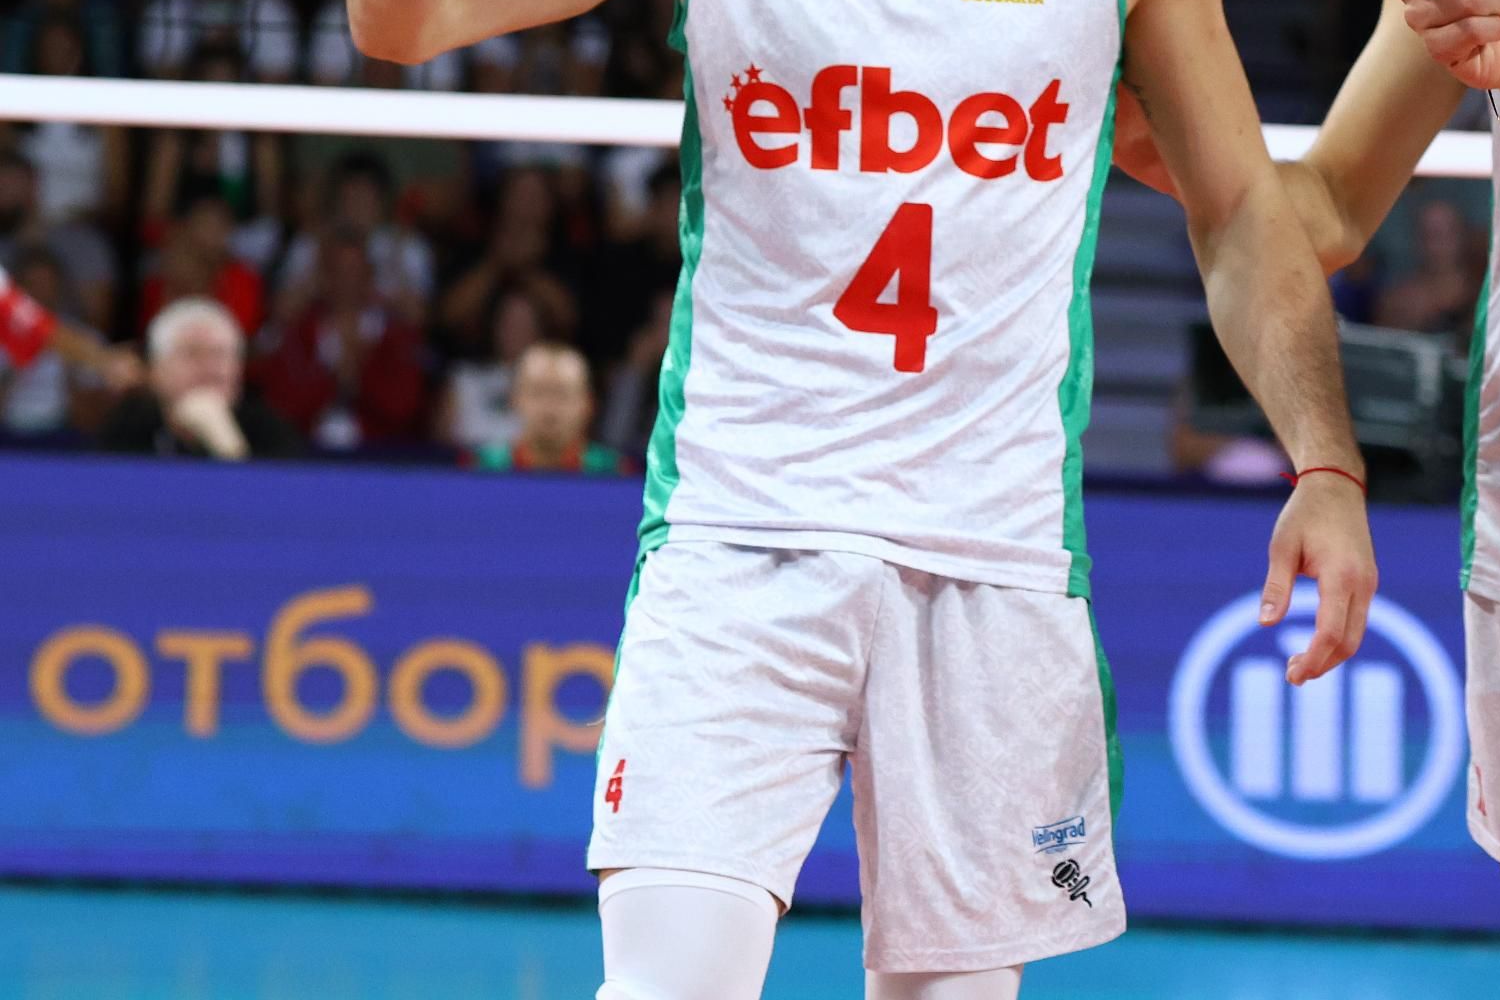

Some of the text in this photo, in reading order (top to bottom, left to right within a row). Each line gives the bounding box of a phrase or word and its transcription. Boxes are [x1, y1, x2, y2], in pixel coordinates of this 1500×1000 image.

[729, 64, 1069, 182] efbet
[833, 202, 938, 373] 4
[605, 758, 626, 814] 4
